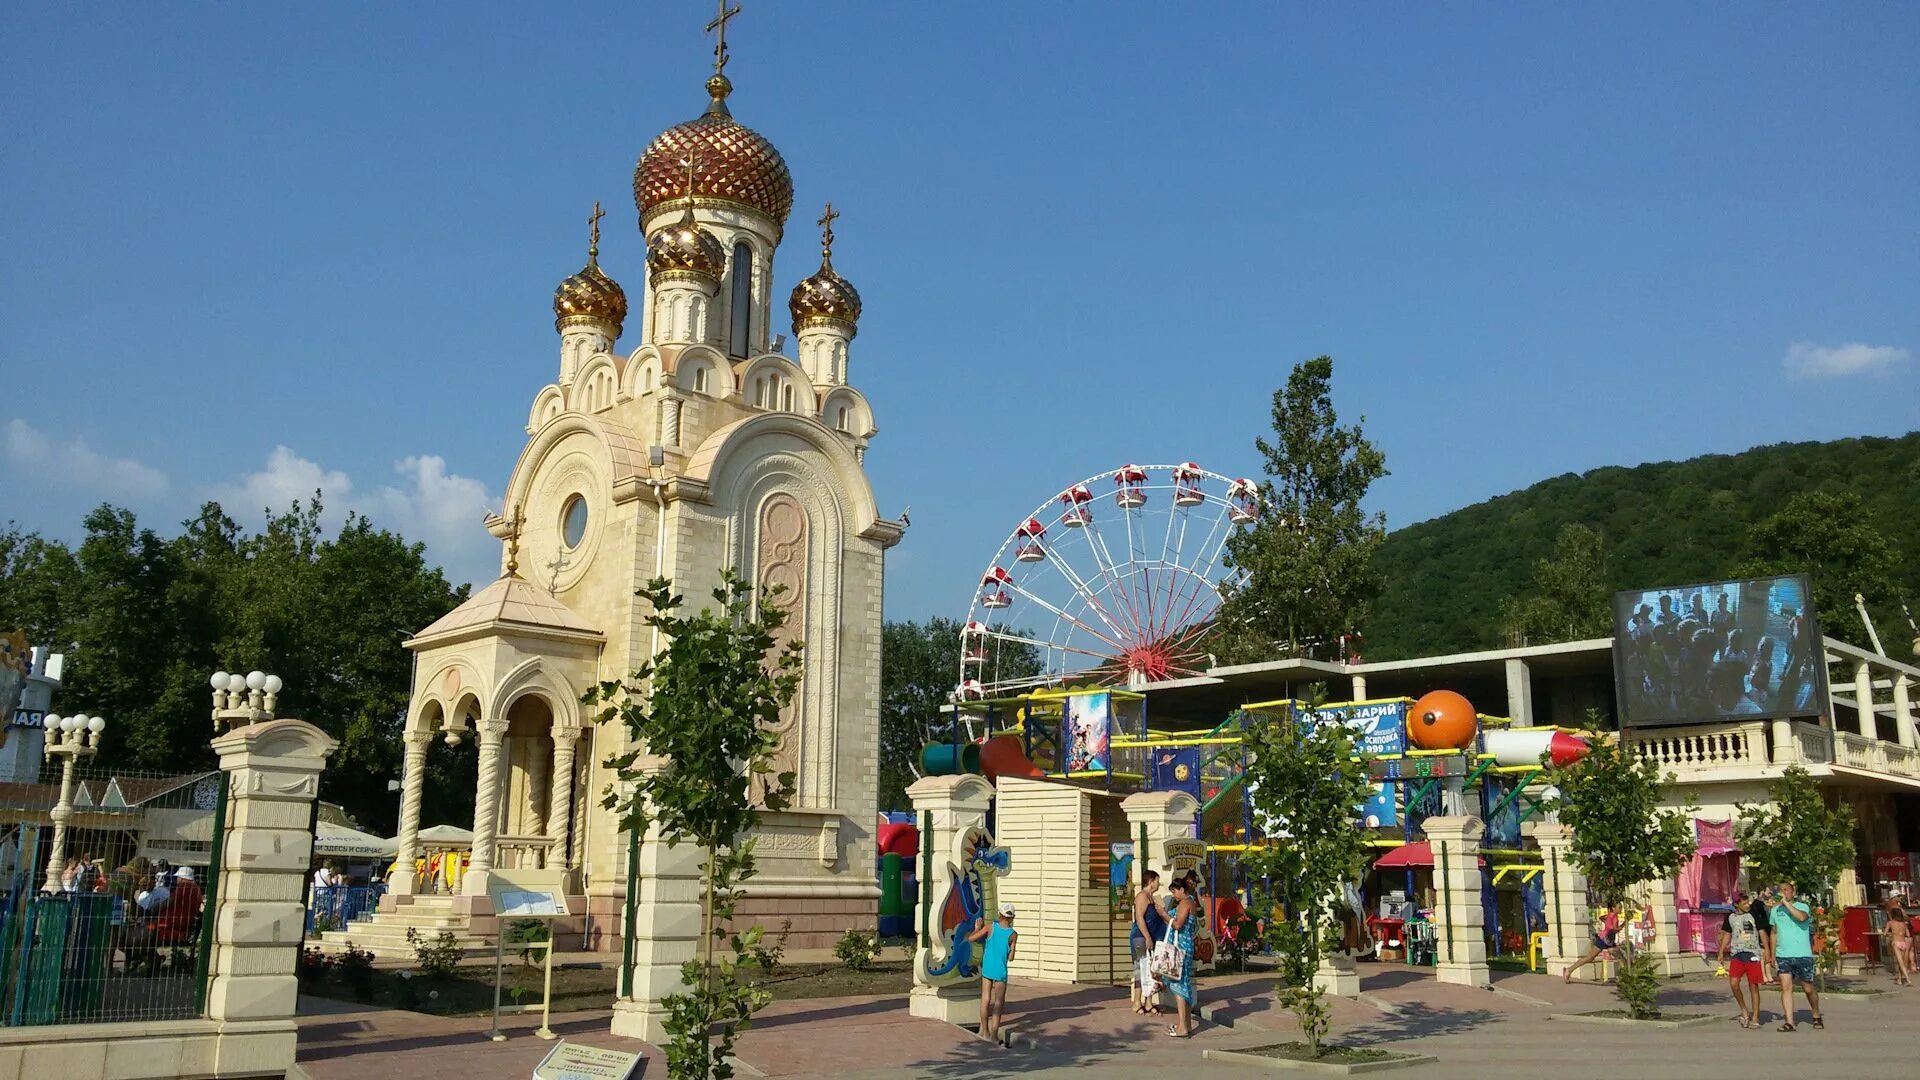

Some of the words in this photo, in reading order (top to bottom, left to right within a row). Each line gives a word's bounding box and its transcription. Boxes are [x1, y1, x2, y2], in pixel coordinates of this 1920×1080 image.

[1365, 733, 1399, 744] ОСИПОВКА
[355, 846, 383, 854] СЕЙЧАС
[1876, 856, 1906, 867] Coca-Cola
